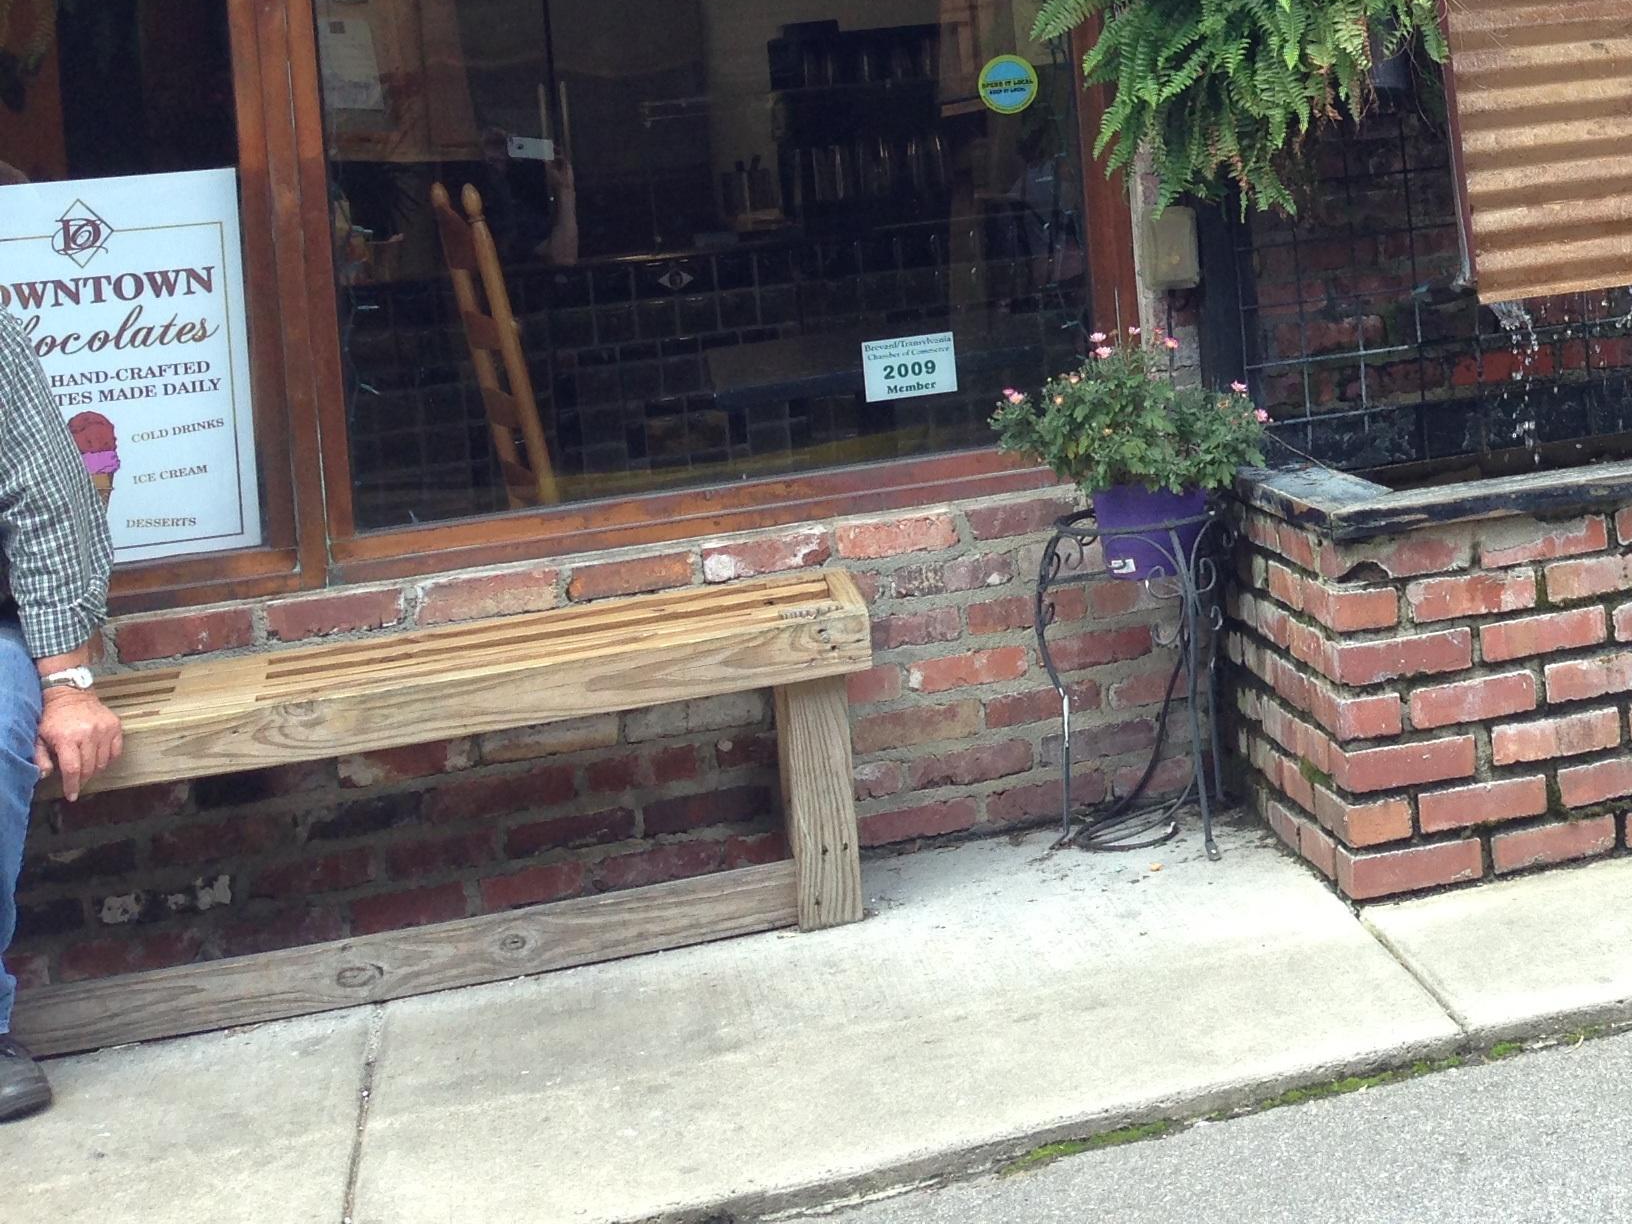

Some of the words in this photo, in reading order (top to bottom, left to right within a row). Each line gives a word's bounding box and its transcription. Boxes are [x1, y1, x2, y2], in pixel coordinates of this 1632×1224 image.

[0, 266, 215, 310] WNTOWN
[22, 304, 220, 357] ocolates
[51, 360, 210, 388] HAND-CRAFTED
[883, 360, 936, 380] 2009
[99, 384, 157, 402] MADE
[163, 378, 221, 396] DAILY
[887, 381, 937, 394] Member
[131, 429, 168, 443] COLD
[172, 417, 225, 436] DRINKS
[133, 473, 156, 485] ICE
[160, 464, 208, 480] CREAM
[126, 517, 197, 528] DESSERTS
